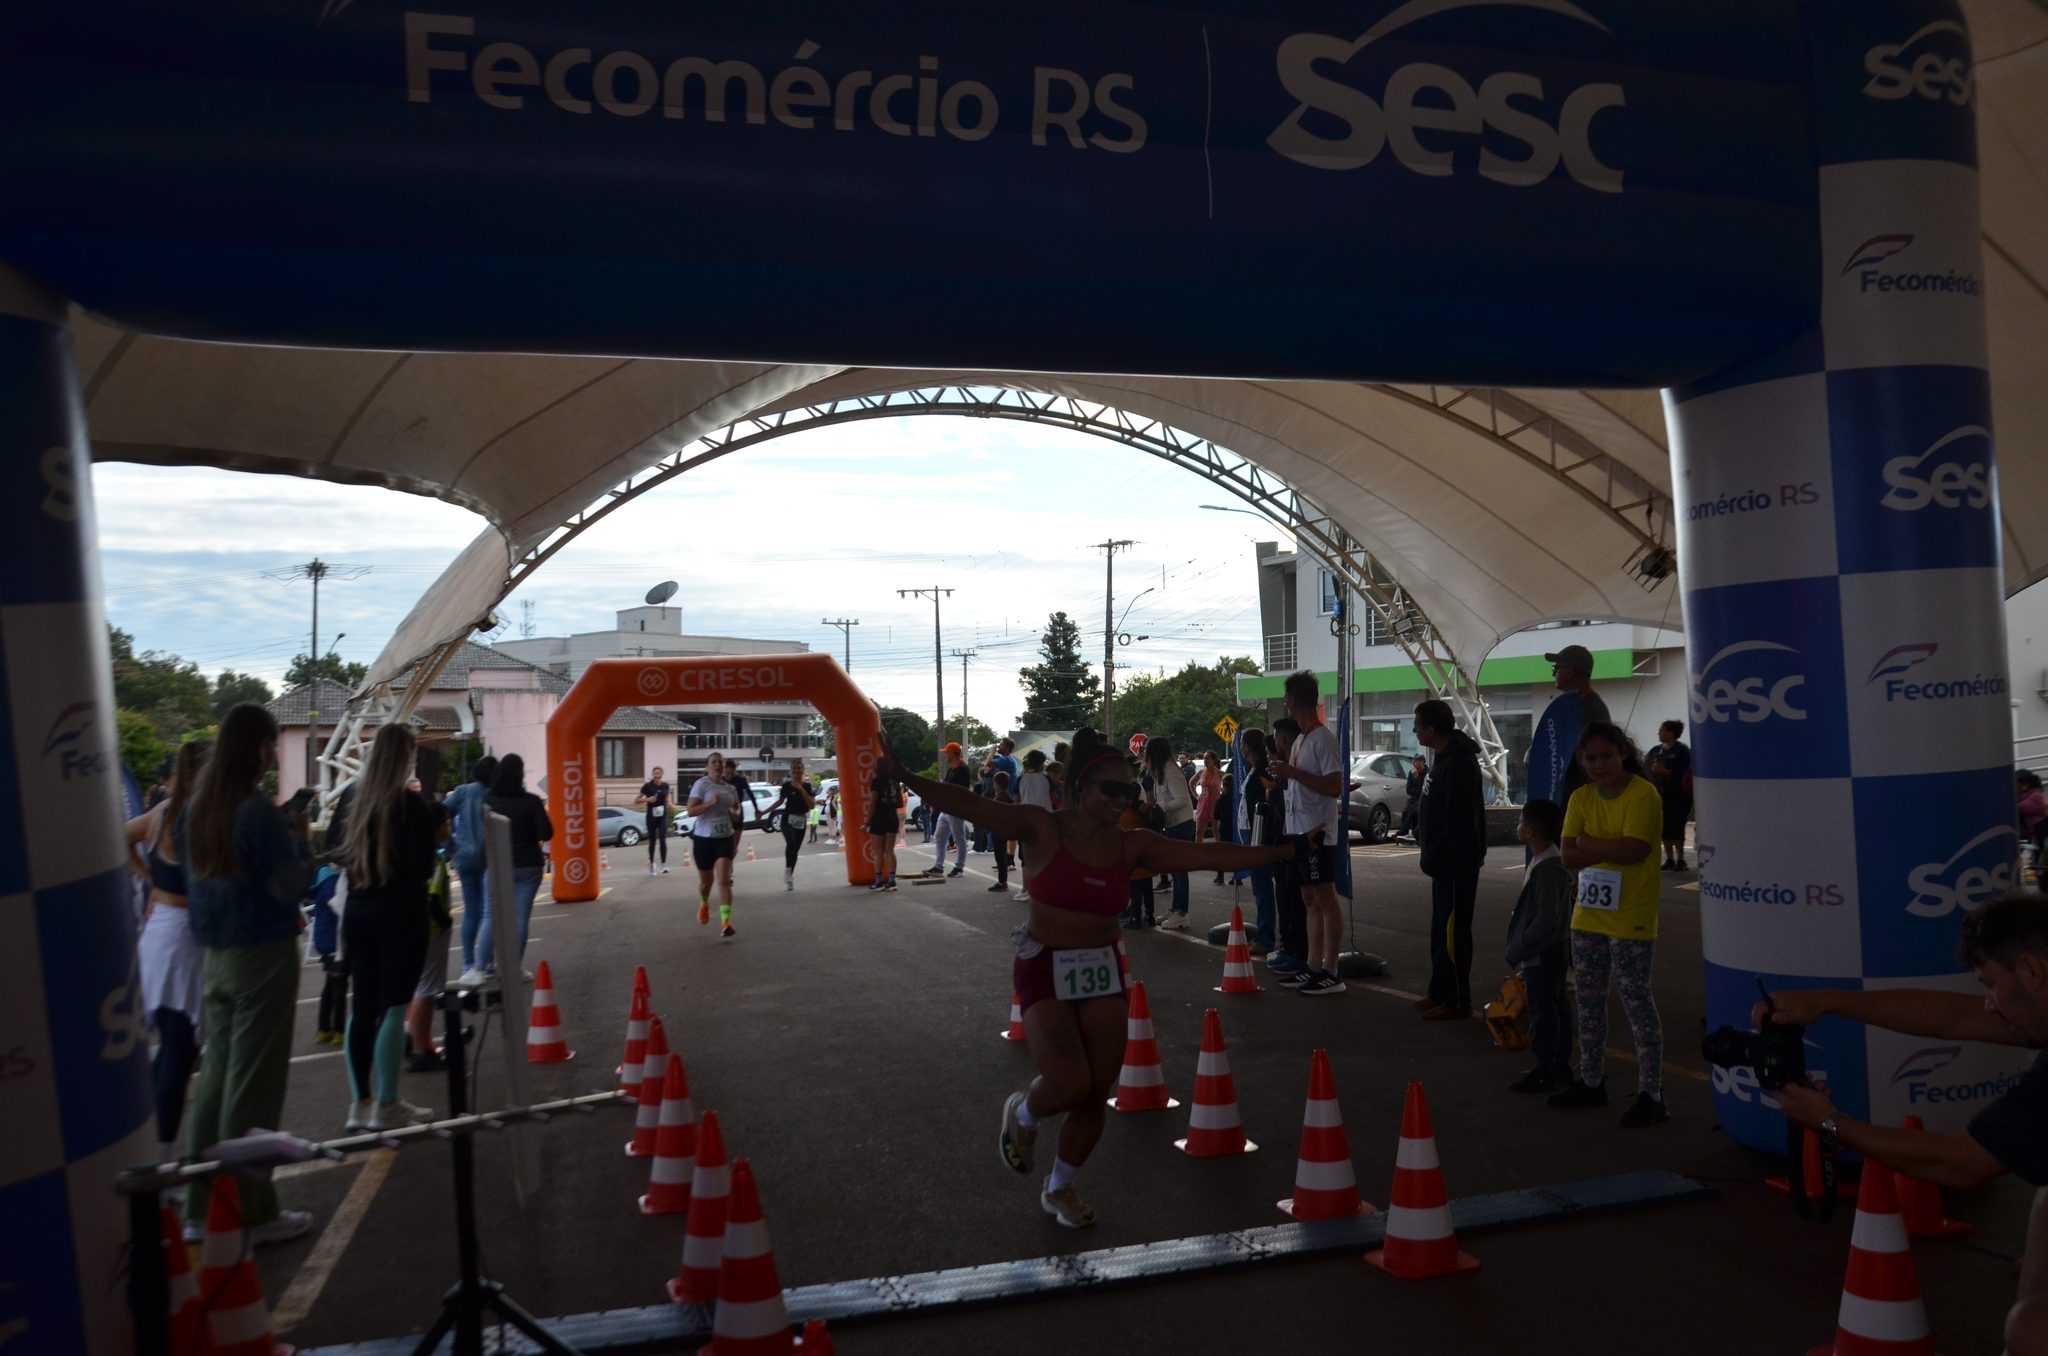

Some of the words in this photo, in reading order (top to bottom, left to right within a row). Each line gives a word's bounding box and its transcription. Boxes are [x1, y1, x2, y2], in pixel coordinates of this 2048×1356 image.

[405, 11, 1000, 142] Fecomércio
[1031, 66, 1148, 154] RS
[1862, 43, 1971, 106] Ses
[1780, 482, 1820, 508] RS
[1880, 455, 1993, 511] Ses
[678, 666, 794, 692] CRESOL
[562, 752, 587, 850] CRESOL
[1805, 884, 1845, 906] RS
[1064, 965, 1111, 995] 139
